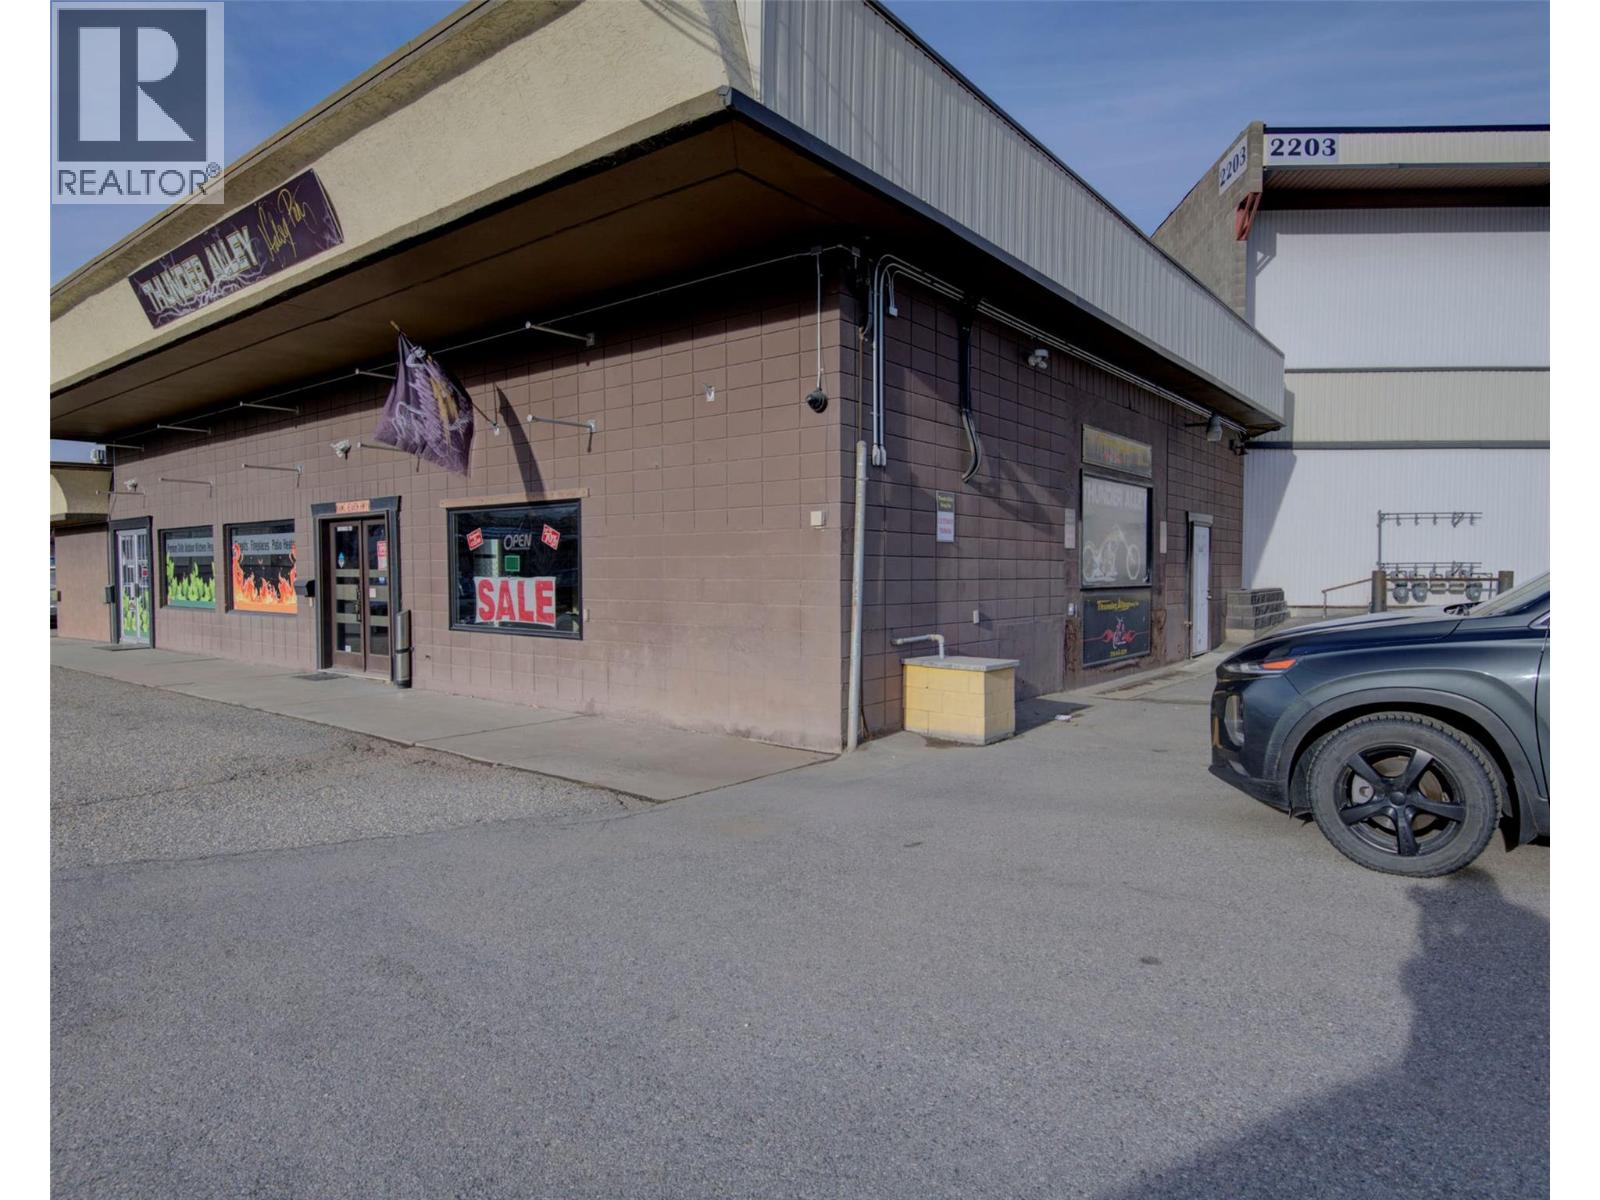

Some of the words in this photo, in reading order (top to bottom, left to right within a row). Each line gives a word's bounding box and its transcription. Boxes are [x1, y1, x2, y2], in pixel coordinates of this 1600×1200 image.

[1220, 146, 1246, 186] 2203
[1270, 138, 1336, 156] 2203
[141, 254, 211, 312] THUNDER
[204, 225, 258, 278] ALLEY
[504, 534, 532, 550] OPEN
[478, 579, 555, 623] SALE
